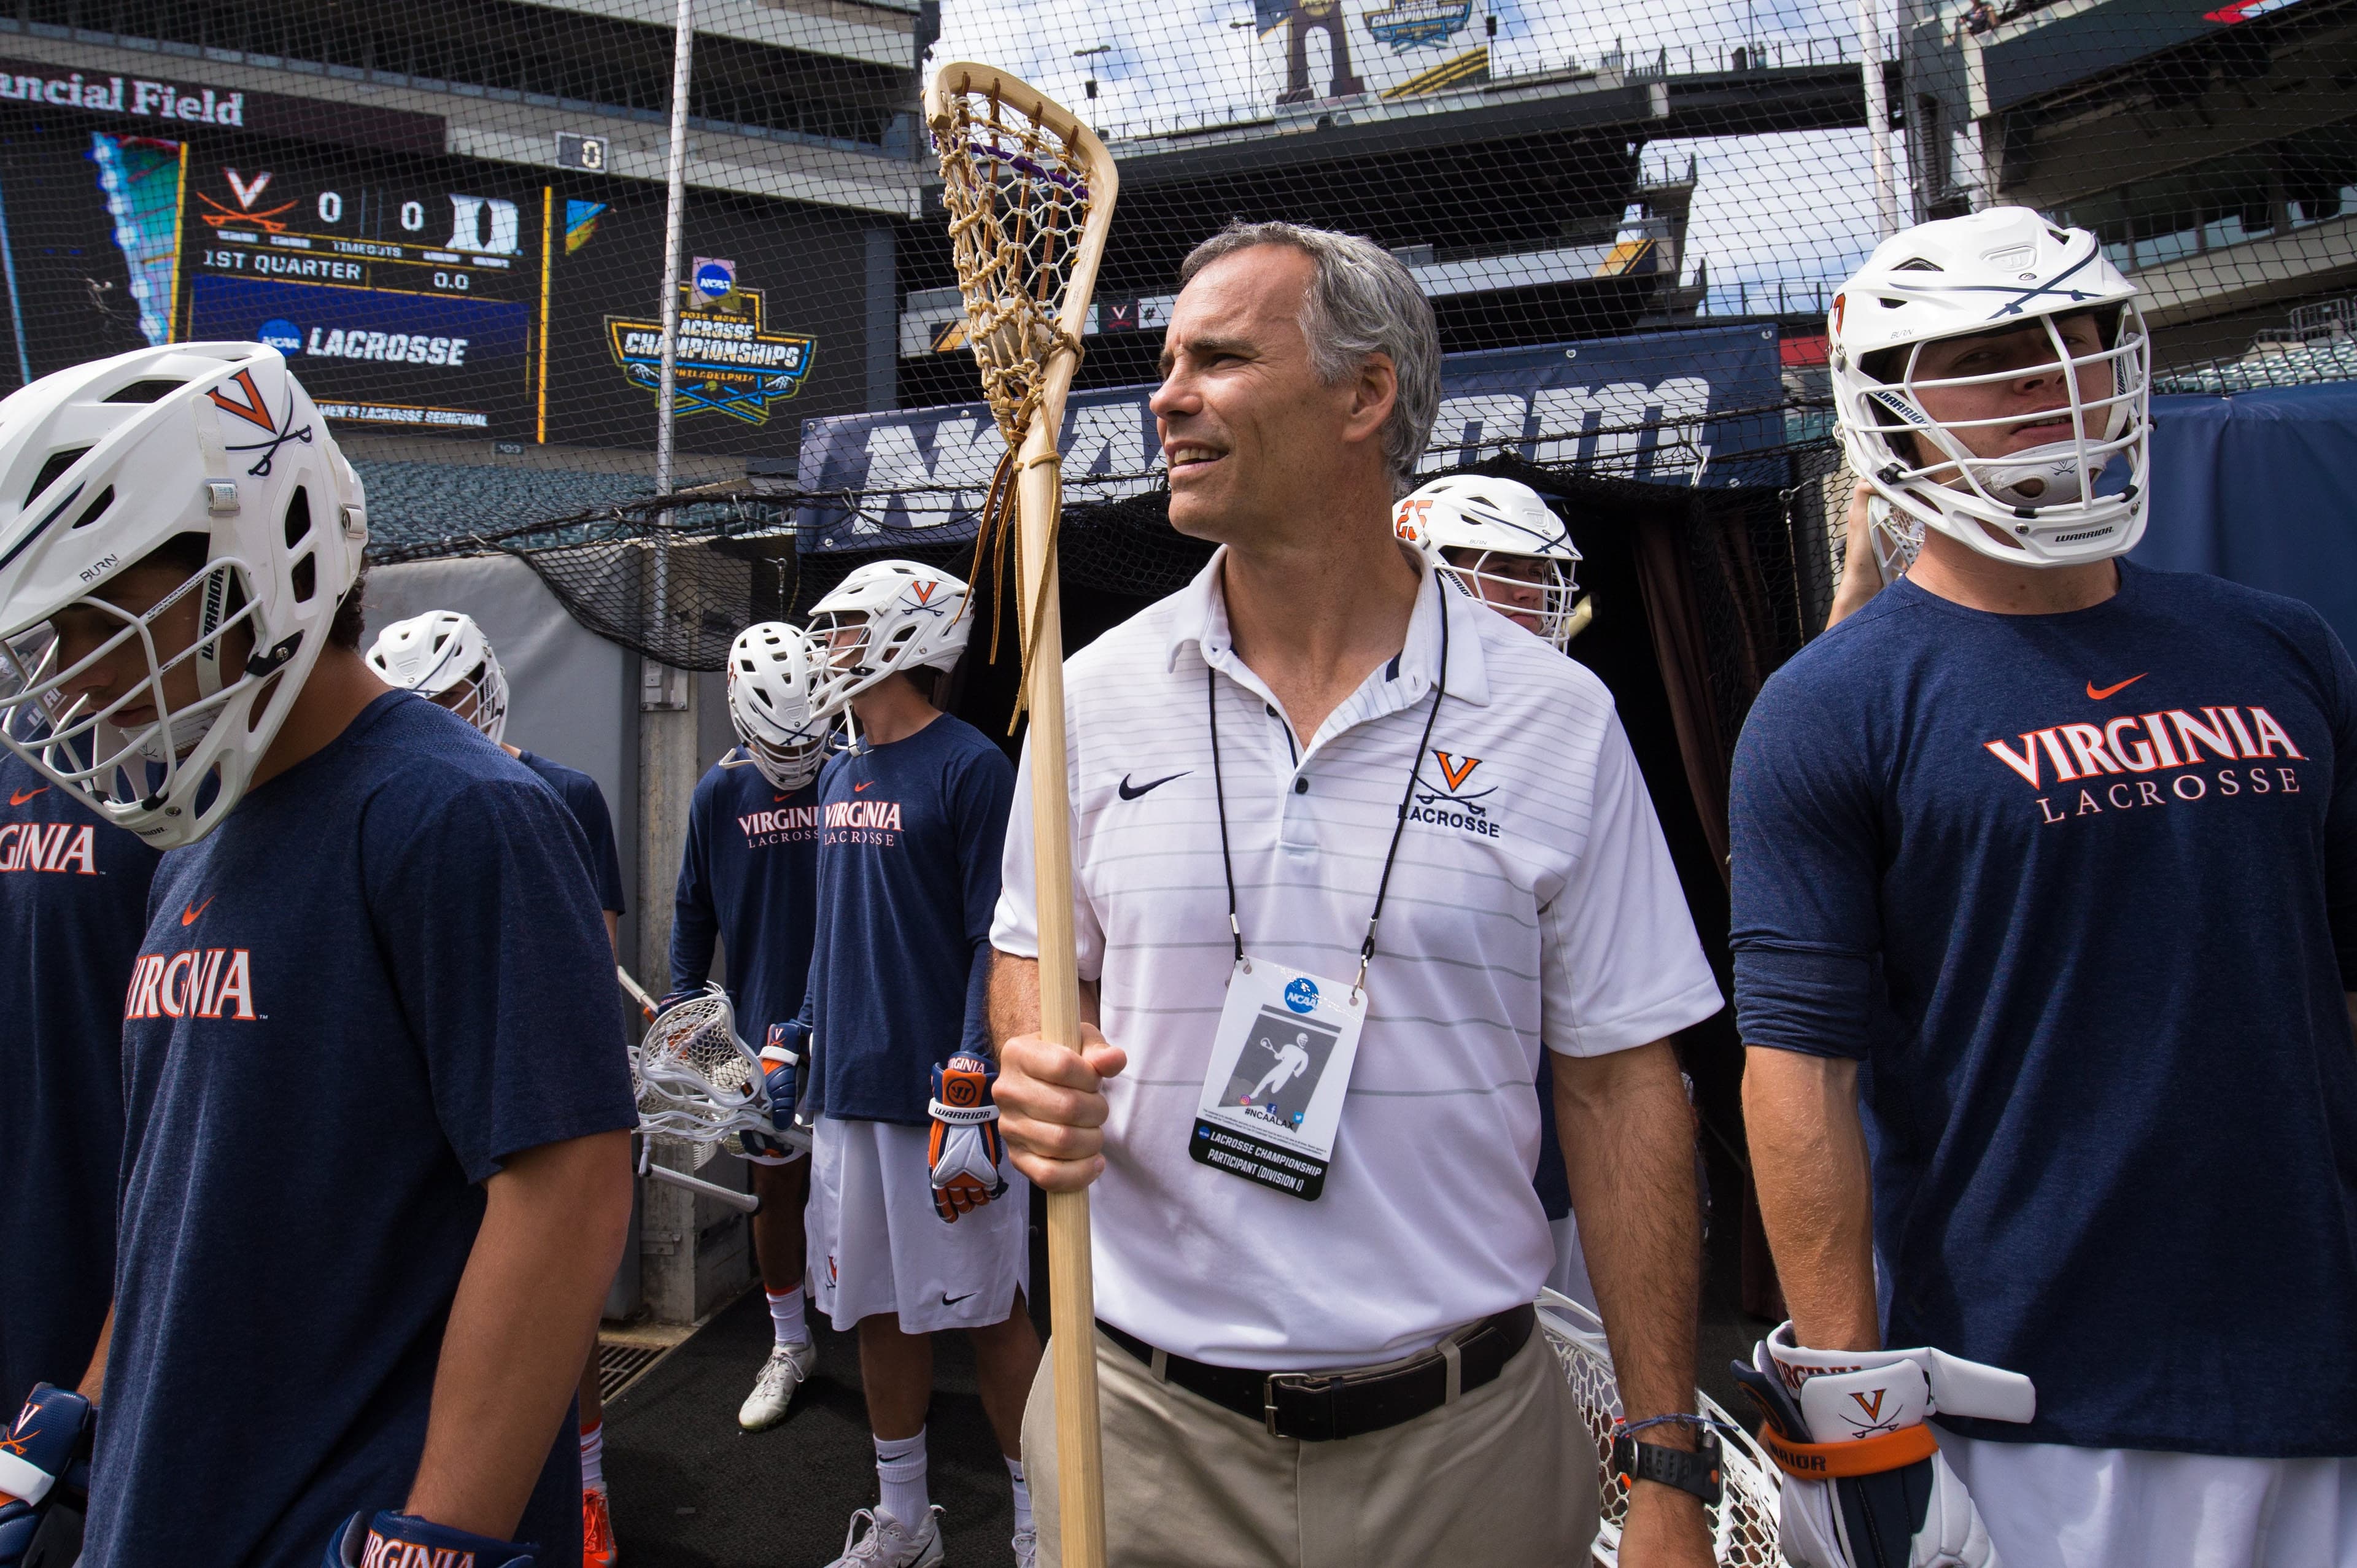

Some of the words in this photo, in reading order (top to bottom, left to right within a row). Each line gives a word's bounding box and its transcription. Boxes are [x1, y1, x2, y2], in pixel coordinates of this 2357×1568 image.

[1371, 5, 1465, 28] CHAMPIONSHIPS
[130, 80, 245, 126] Field
[318, 191, 343, 223] 0
[401, 201, 424, 232] 0
[331, 240, 403, 258] TIMEOUTS
[203, 249, 246, 269] 1ST
[254, 255, 362, 280] QUARTER
[433, 271, 469, 290] 0.0
[306, 326, 469, 367] LACROSSE
[1891, 329, 1913, 339] BURN
[318, 404, 359, 419] MEN'S
[360, 406, 425, 423] LACROSSE
[425, 410, 489, 427] SEMIFINAL
[2055, 526, 2113, 543] WARRIOR
[79, 554, 120, 582] BURN
[1983, 706, 2305, 790] VIRGINIA
[1431, 749, 1483, 793] V
[2035, 768, 2301, 824] LACROSSE
[825, 801, 902, 830] VIRGINIA
[1398, 804, 1501, 838] LACROSSE
[1287, 992, 1317, 1008] NCAA
[935, 1107, 991, 1119] WARRIOR
[1244, 1106, 1295, 1130] #NCAALAX
[1210, 1131, 1255, 1154] LACROSSE
[1255, 1147, 1322, 1178] CHAMPIONSHIP
[1207, 1148, 1259, 1175] PARTICIPANT
[1258, 1165, 1298, 1191] (DIVISION
[1295, 1180, 1305, 1192] I)
